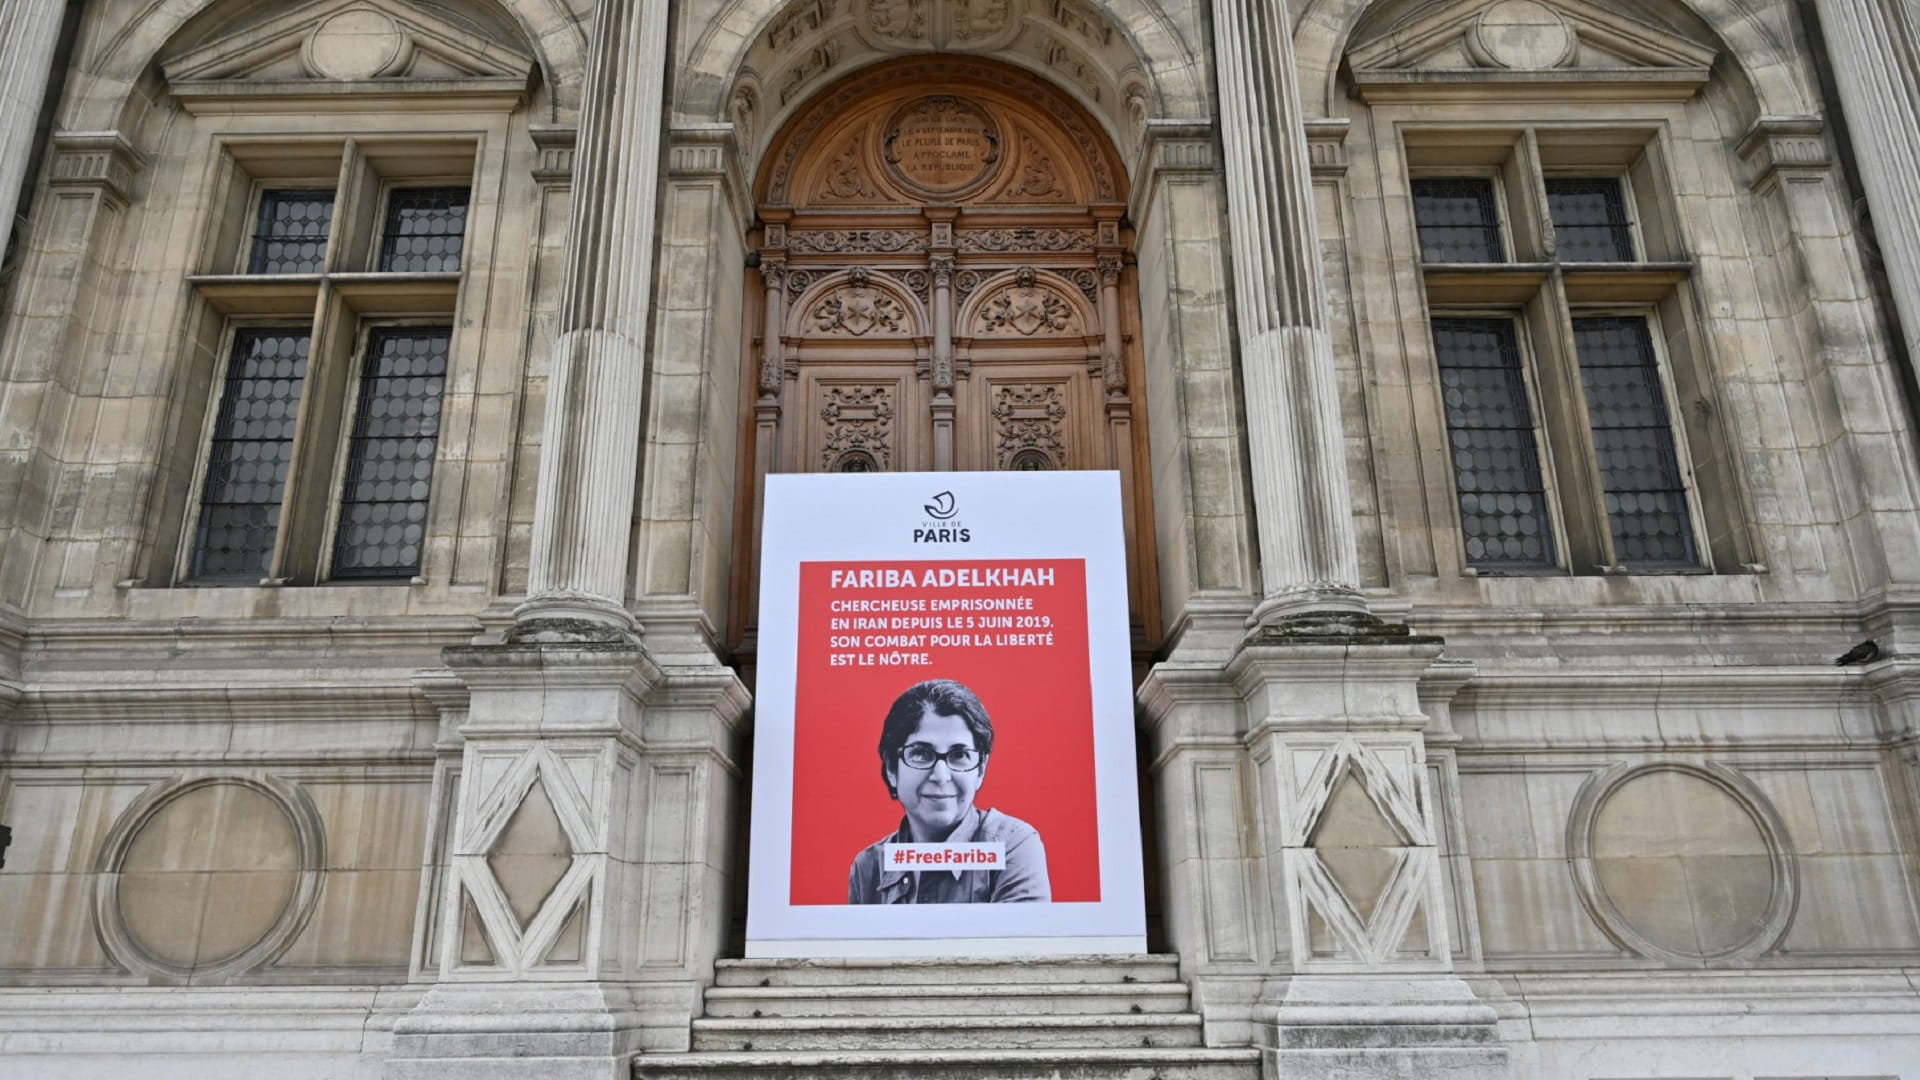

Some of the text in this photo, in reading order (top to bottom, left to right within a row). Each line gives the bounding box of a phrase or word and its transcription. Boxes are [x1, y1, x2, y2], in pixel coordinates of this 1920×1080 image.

[902, 137, 980, 147] LE PEUPLE DE PARIS
[913, 151, 919, 159] A
[906, 164, 918, 172] LA
[913, 528, 971, 543] PARIS
[831, 567, 1055, 589] FARIBA ADELKHAH
[830, 595, 1034, 612] CHERCHEUSE EMPRISONNÉE
[831, 615, 1054, 630] EN IRAN DEPUIS LE 5 JUIN 2019.
[830, 631, 1054, 648] SON COMBAT POUR LA LIBERTÉ
[830, 650, 933, 666] EST LE NÔTRE.
[894, 849, 997, 864] #FreeFariba
